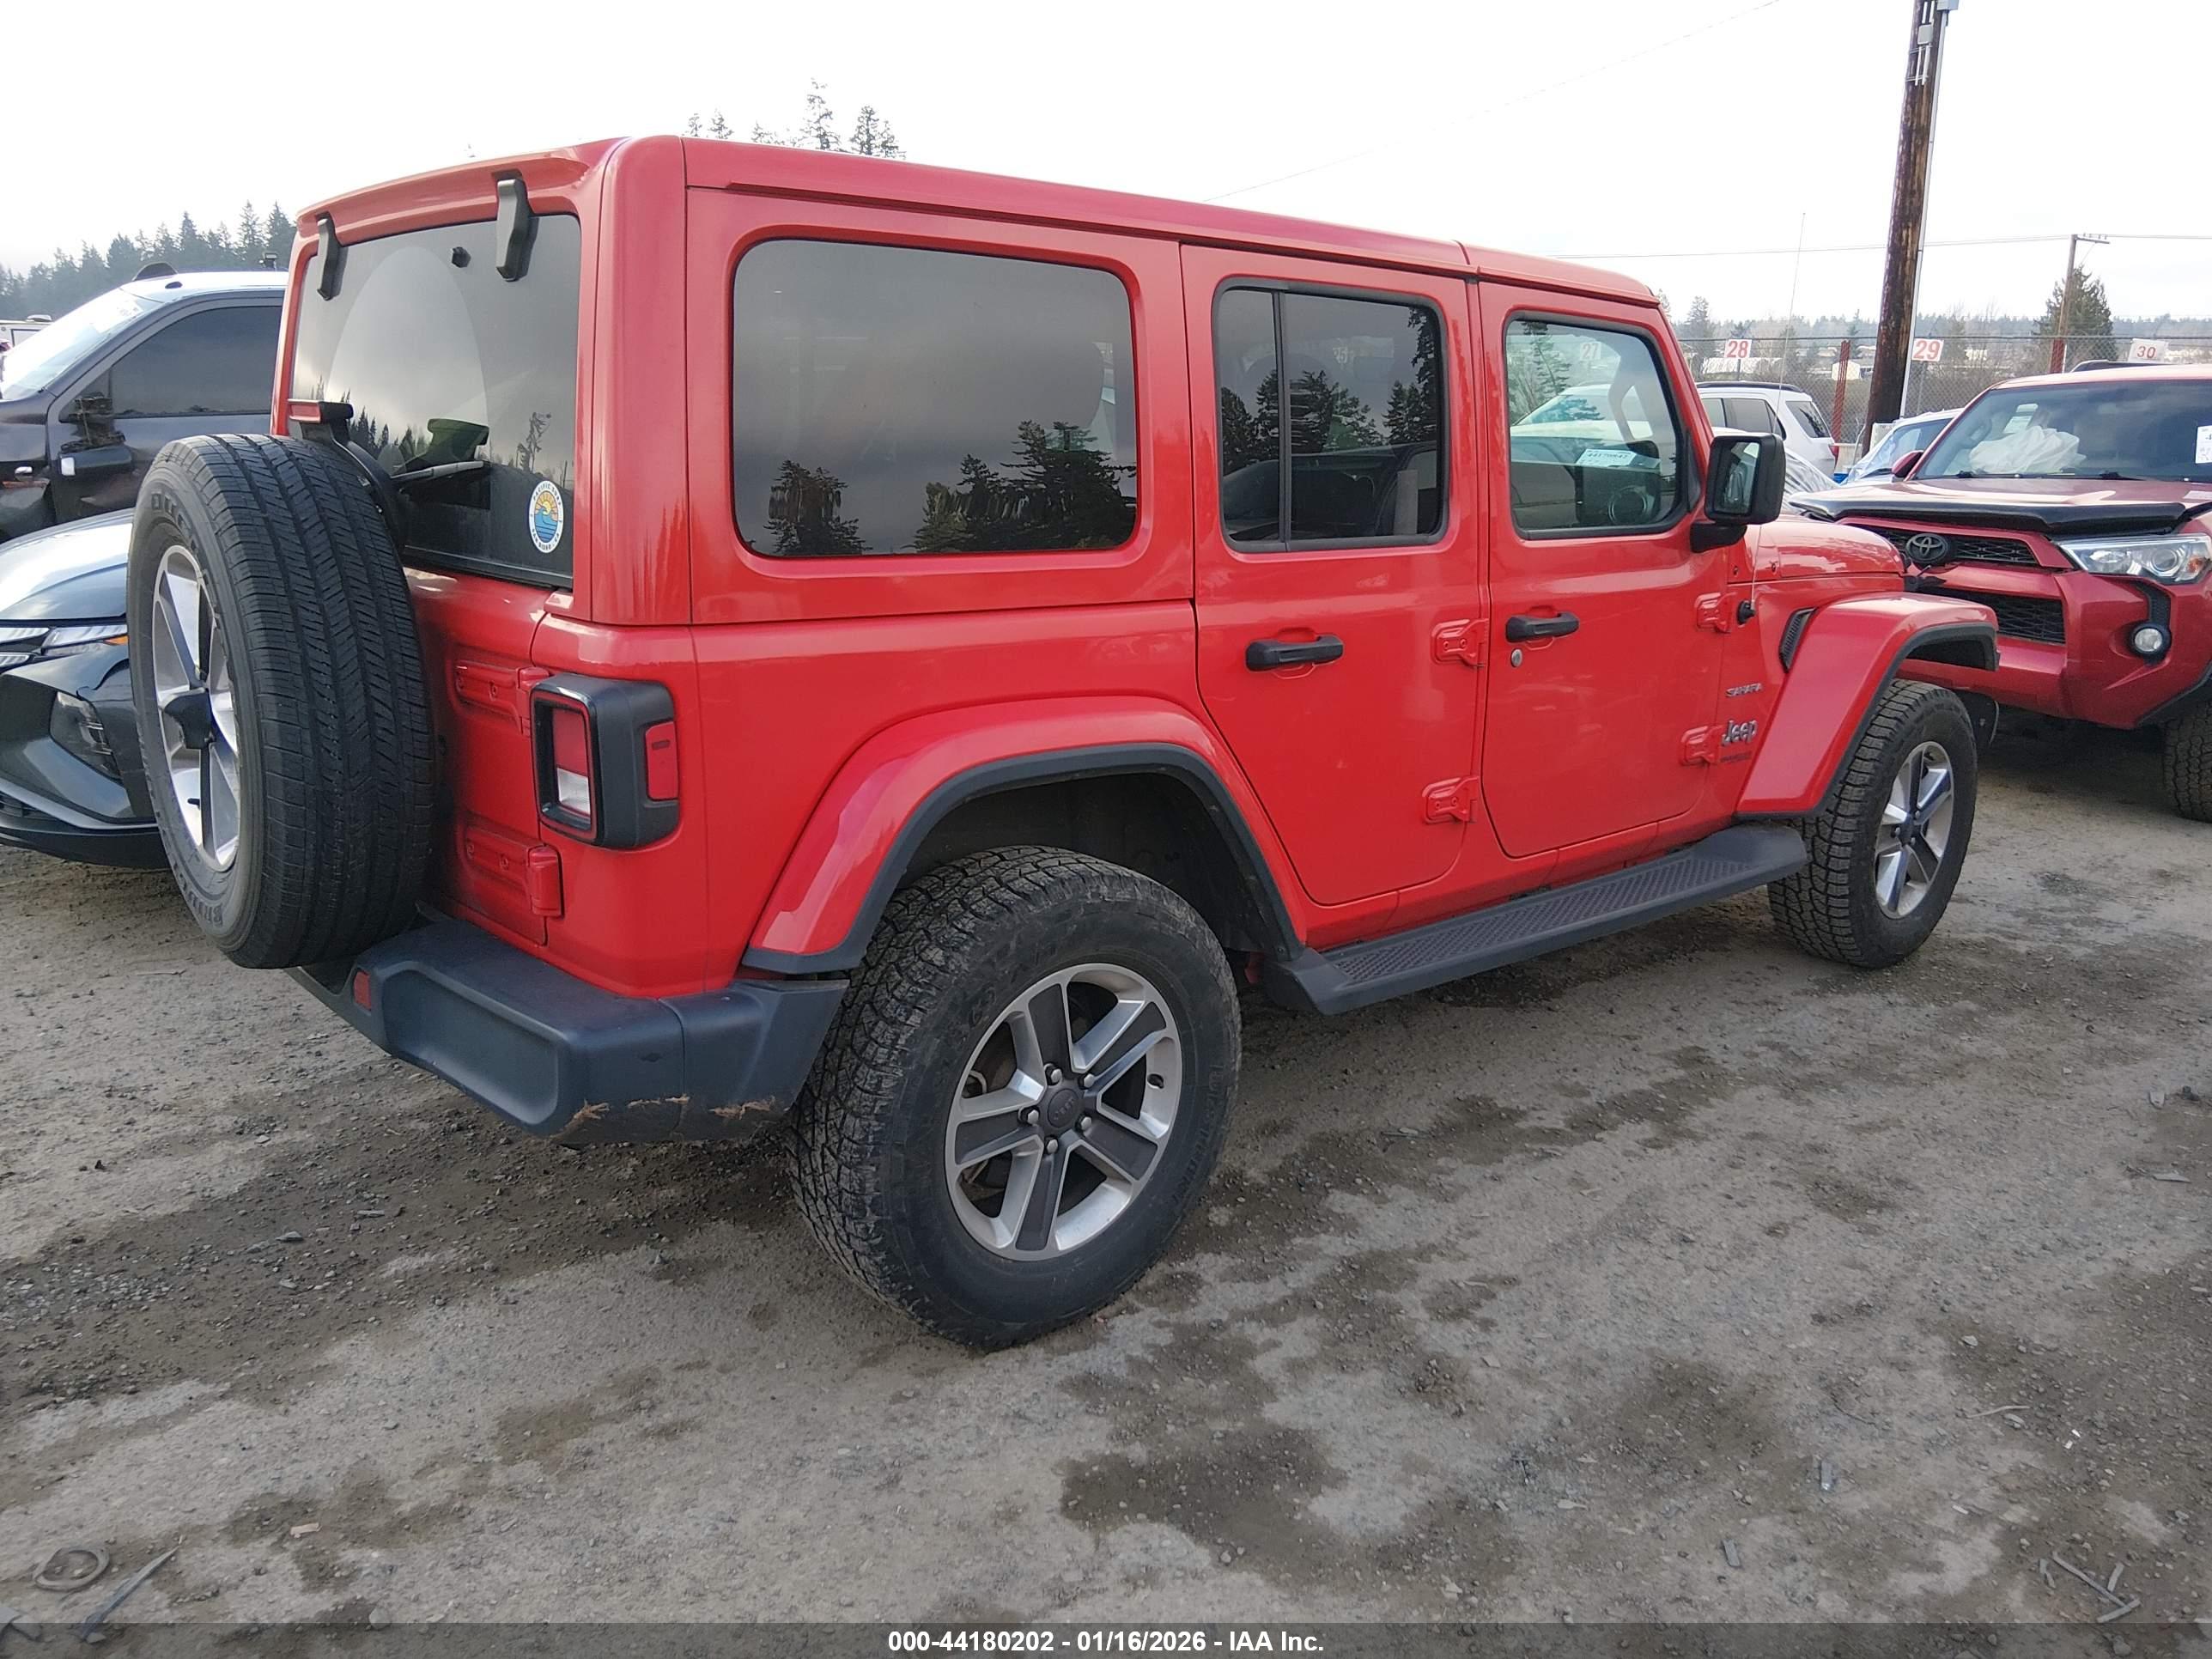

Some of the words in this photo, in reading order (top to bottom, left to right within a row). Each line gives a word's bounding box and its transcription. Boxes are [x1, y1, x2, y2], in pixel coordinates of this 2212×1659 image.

[1582, 343, 1599, 358] 27
[1726, 340, 1748, 358] 28
[1913, 340, 1941, 359] 29
[2136, 346, 2156, 359] 30
[1722, 719, 1757, 746] Jeep
